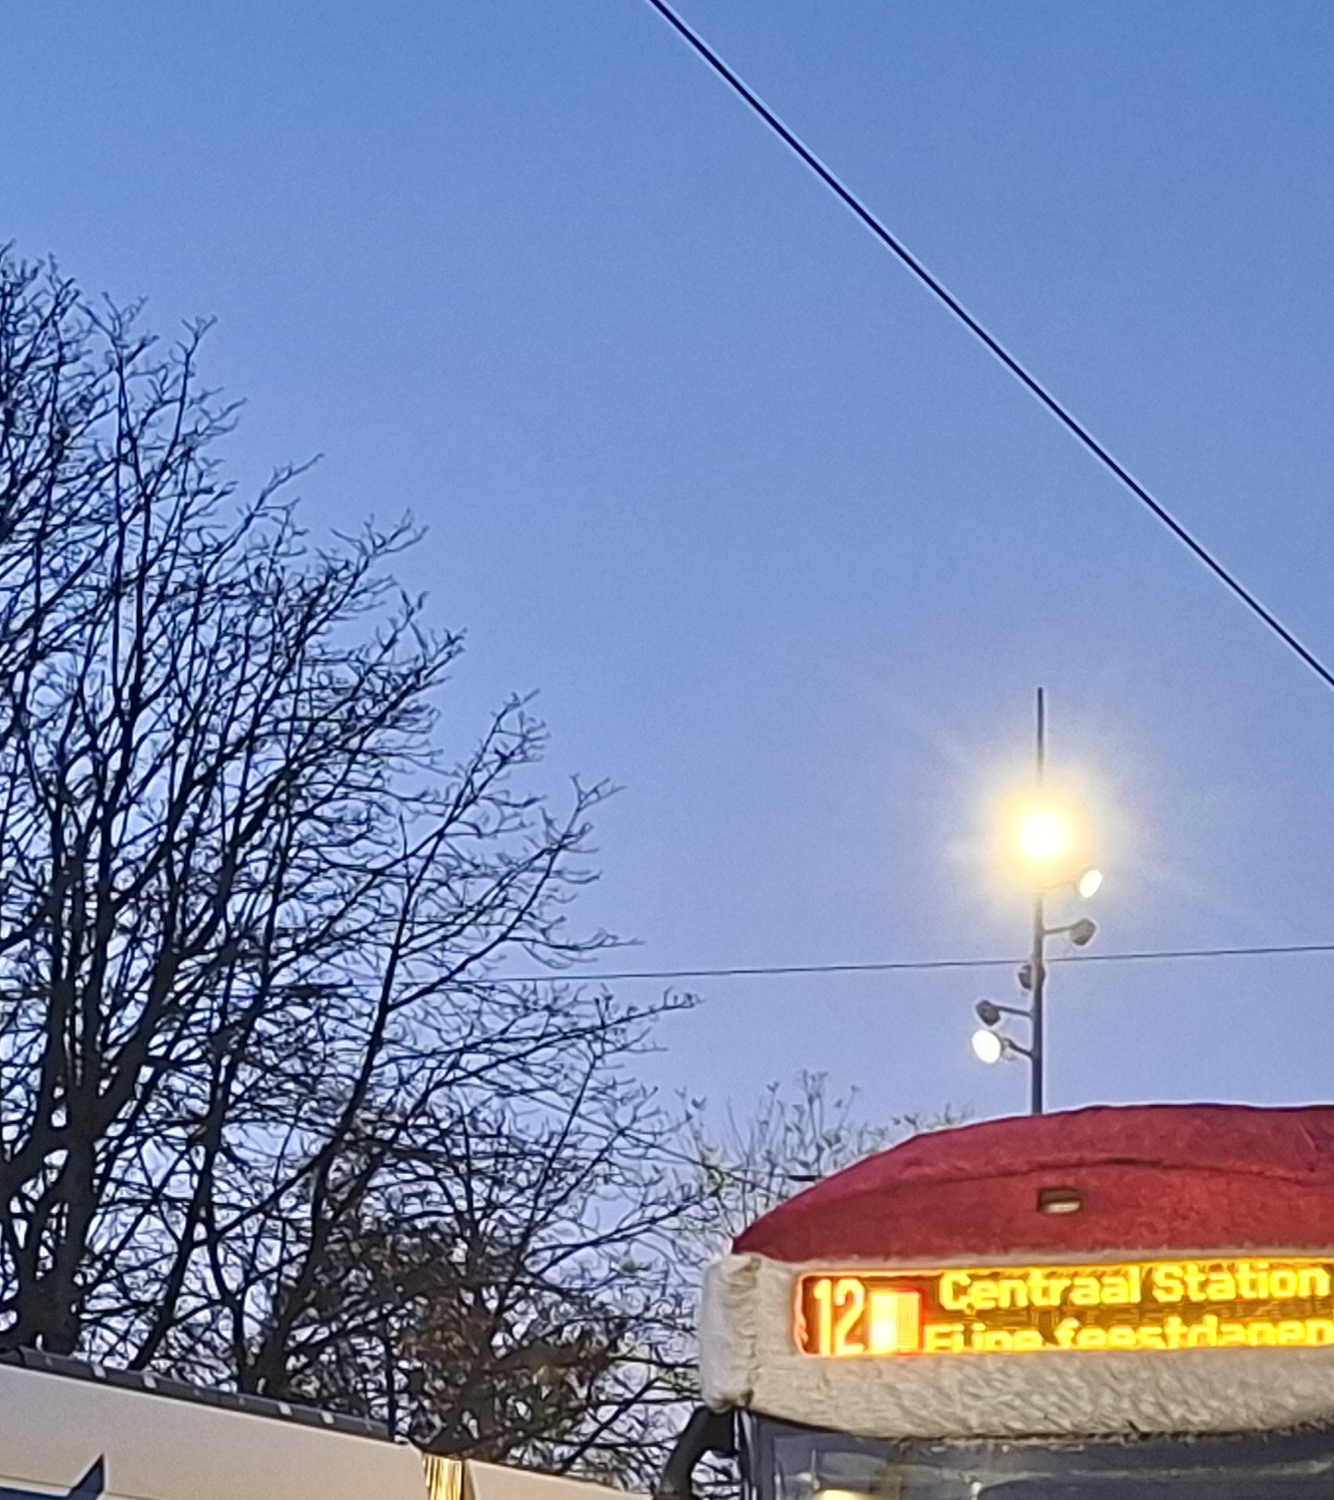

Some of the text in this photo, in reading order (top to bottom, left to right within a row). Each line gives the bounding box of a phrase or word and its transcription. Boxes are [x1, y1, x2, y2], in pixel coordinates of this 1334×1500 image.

[813, 1260, 1332, 1355] 12 Centraal Station
